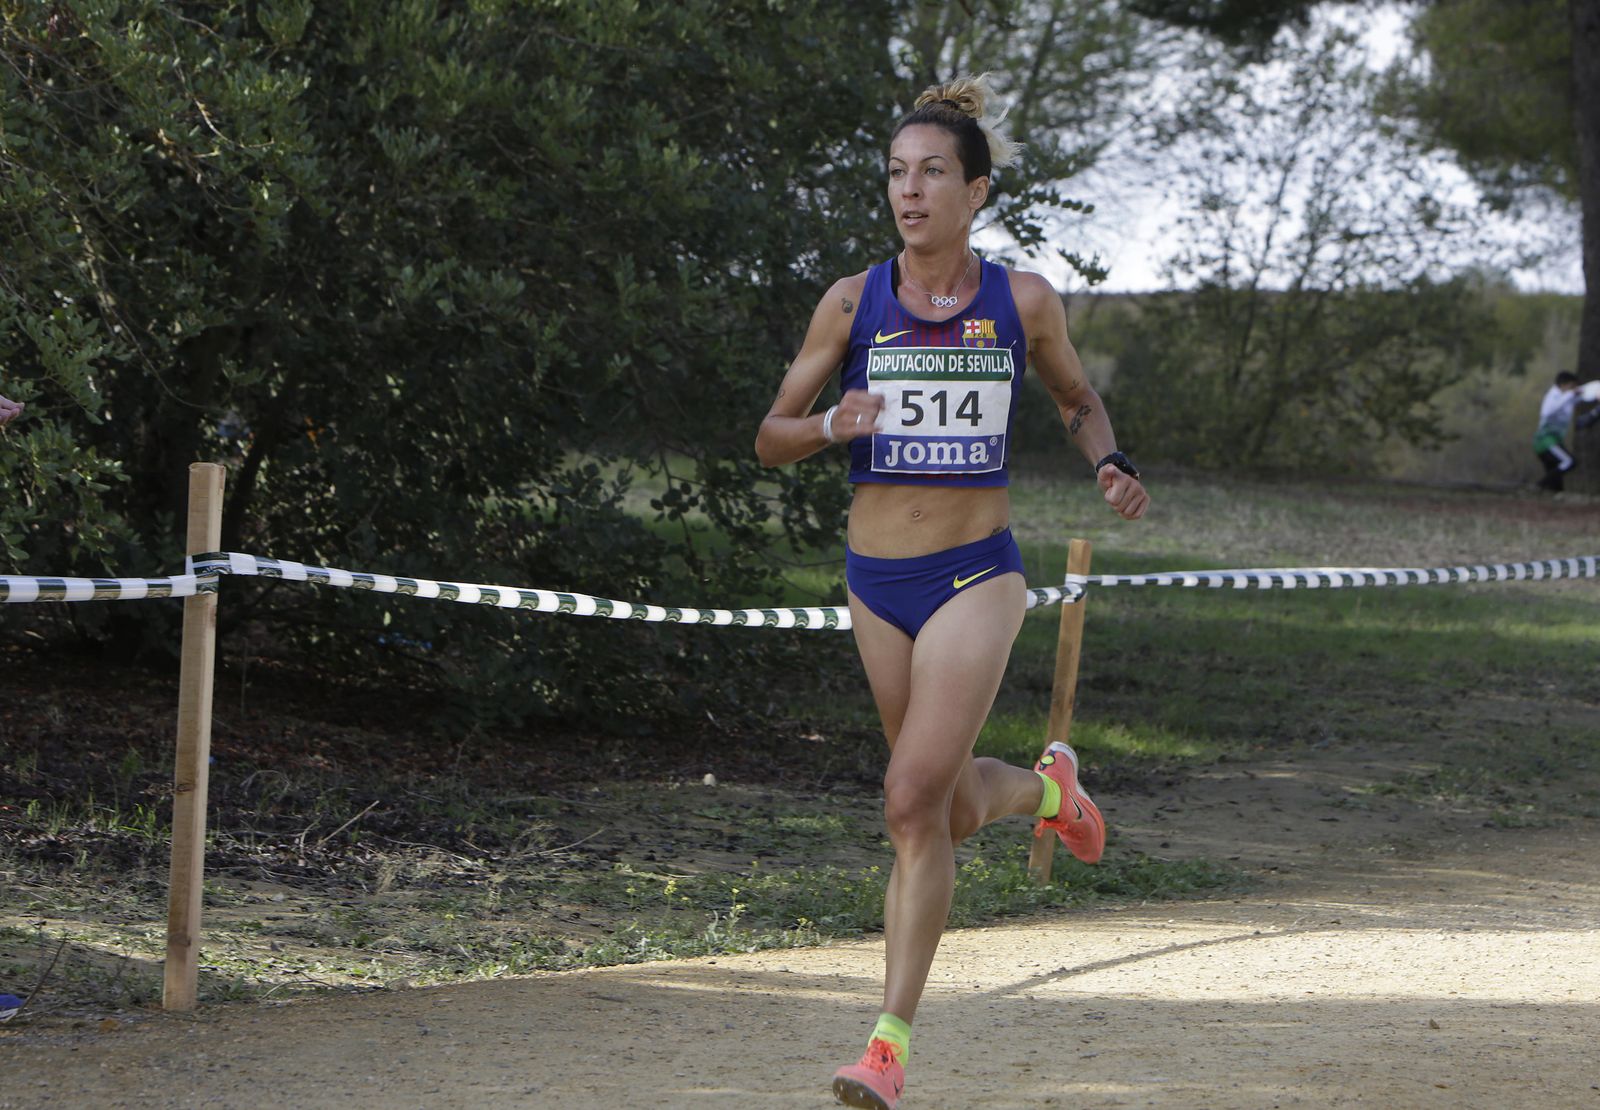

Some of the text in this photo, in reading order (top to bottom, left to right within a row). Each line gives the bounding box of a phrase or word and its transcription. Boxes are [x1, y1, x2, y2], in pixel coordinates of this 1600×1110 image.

[871, 354, 1011, 373] DIPUTACION DE SEVILLA
[901, 390, 983, 427] 514
